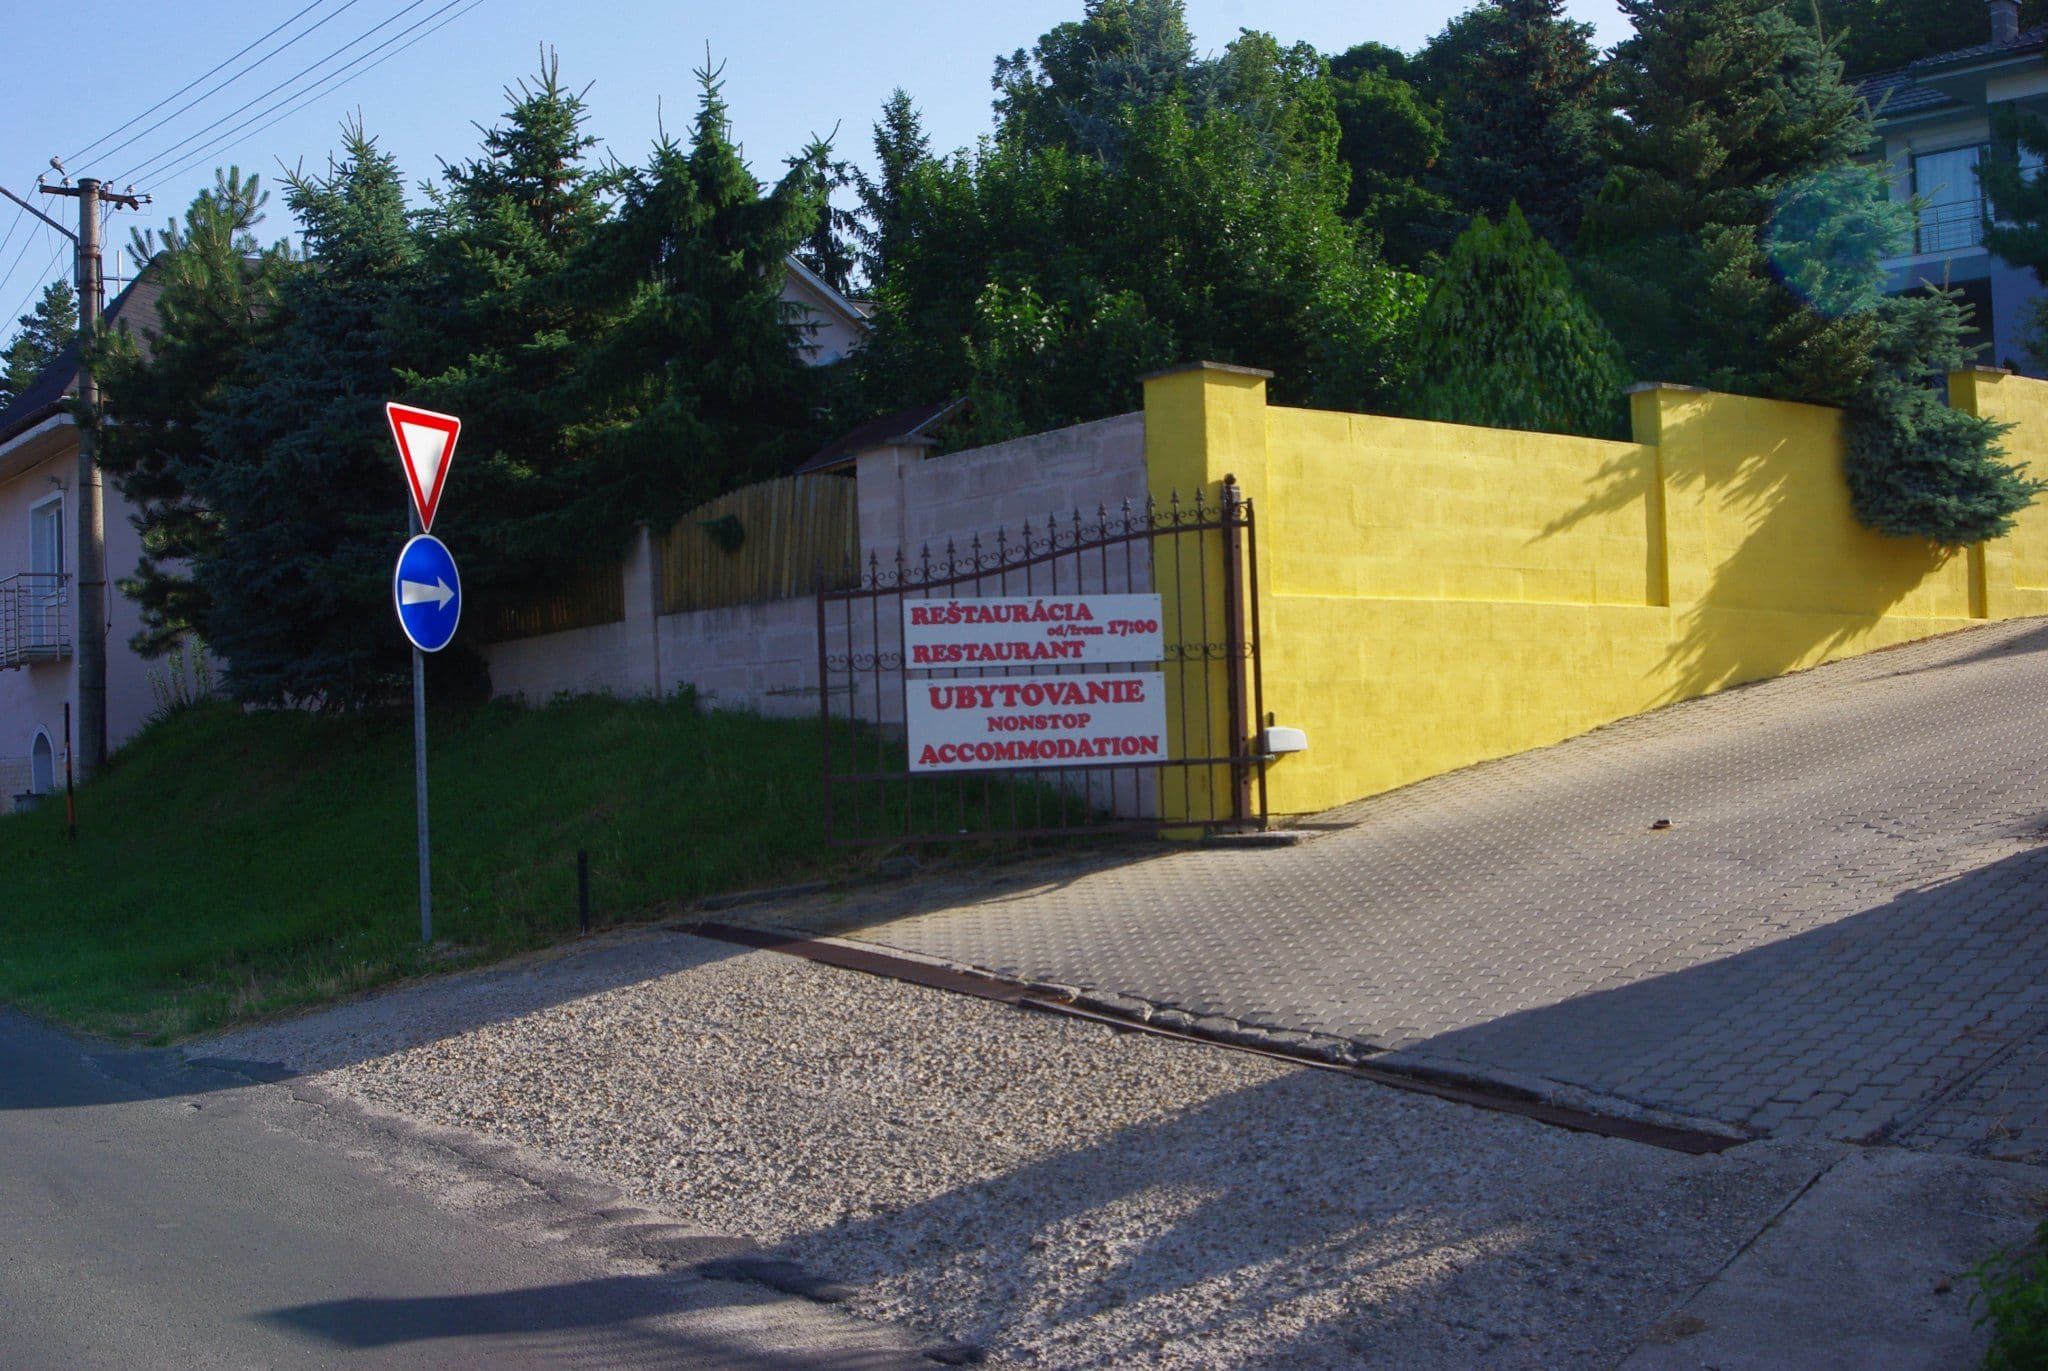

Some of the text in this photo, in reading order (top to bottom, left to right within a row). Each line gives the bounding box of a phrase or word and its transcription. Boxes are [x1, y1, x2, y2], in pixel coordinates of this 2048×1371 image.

[911, 599, 1093, 625] REŠTAURÁCIA
[1047, 620, 1158, 637] od/from 17:00
[913, 641, 1086, 663] RESTAURANT
[928, 680, 1145, 710] UBYTOVANIE
[987, 713, 1091, 732] NONSTOP
[918, 735, 1159, 764] ACCOMMODATION
